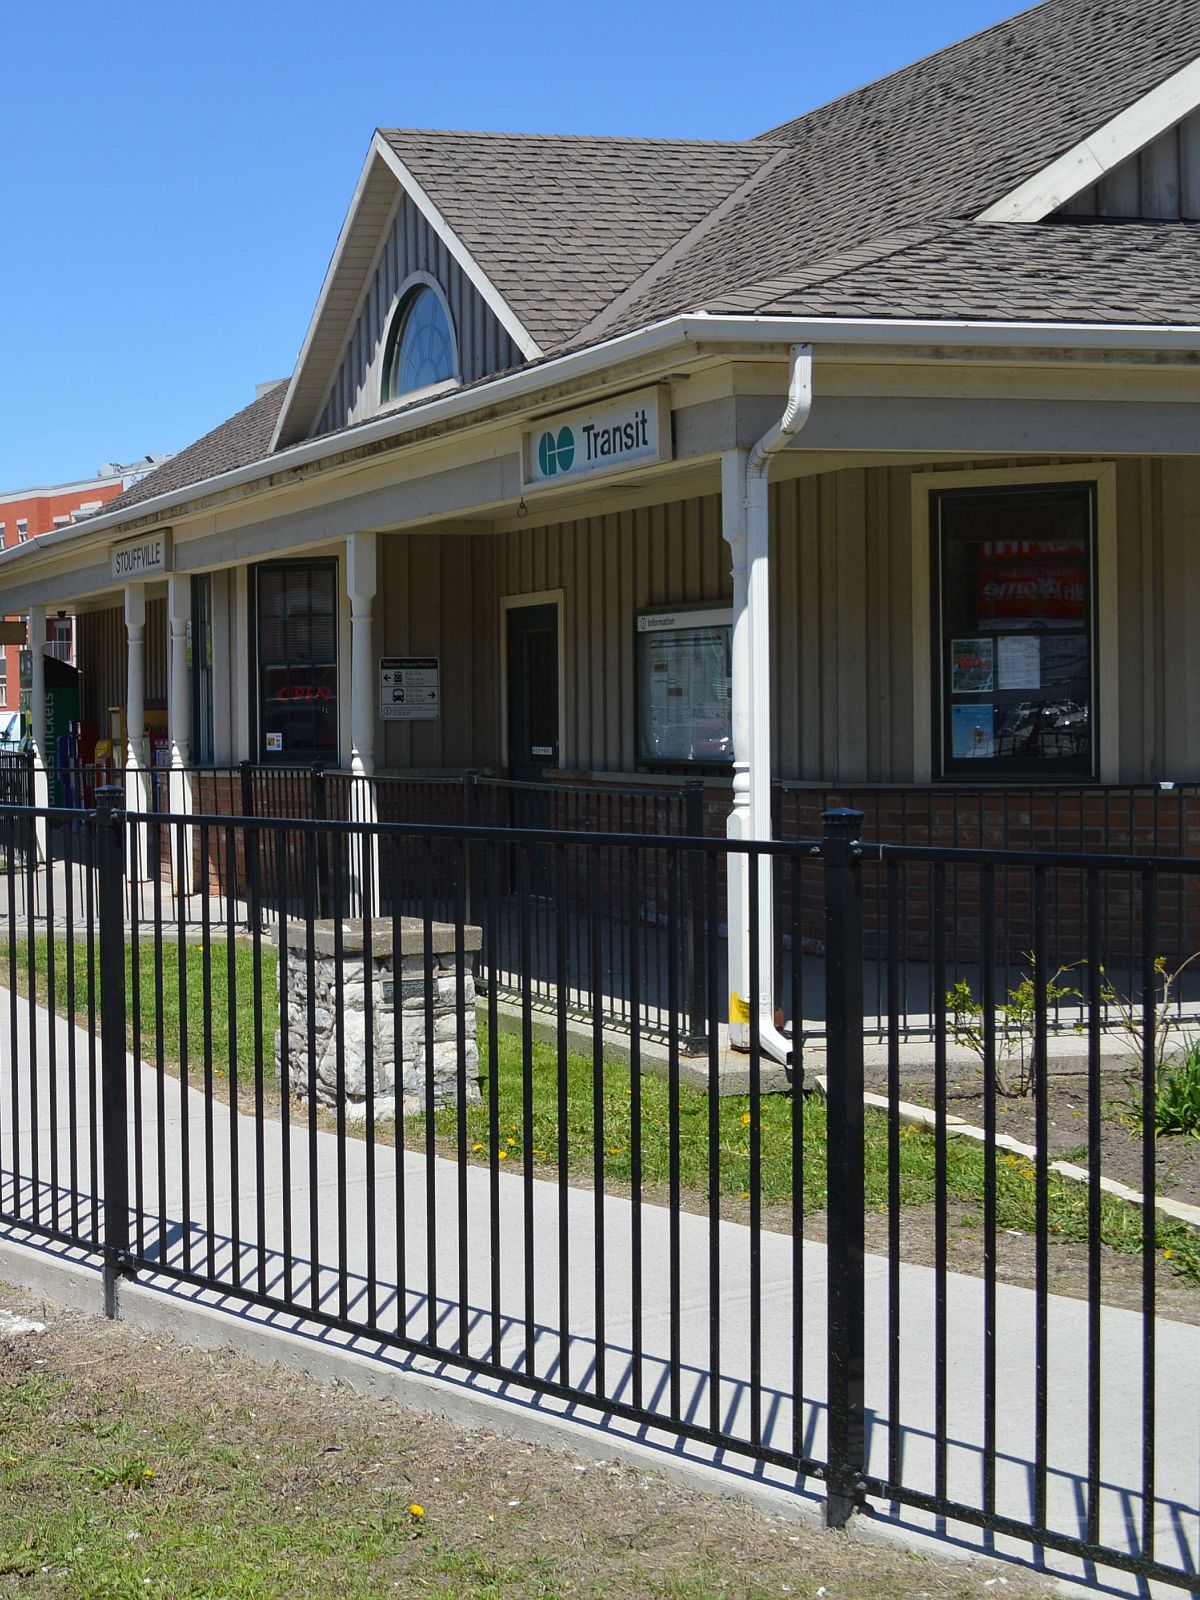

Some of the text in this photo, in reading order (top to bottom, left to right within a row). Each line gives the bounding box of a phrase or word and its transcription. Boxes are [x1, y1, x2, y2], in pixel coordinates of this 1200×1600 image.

[582, 409, 648, 460] Transit
[115, 542, 161, 574] STOUFFVILLE
[647, 618, 675, 627] Information
